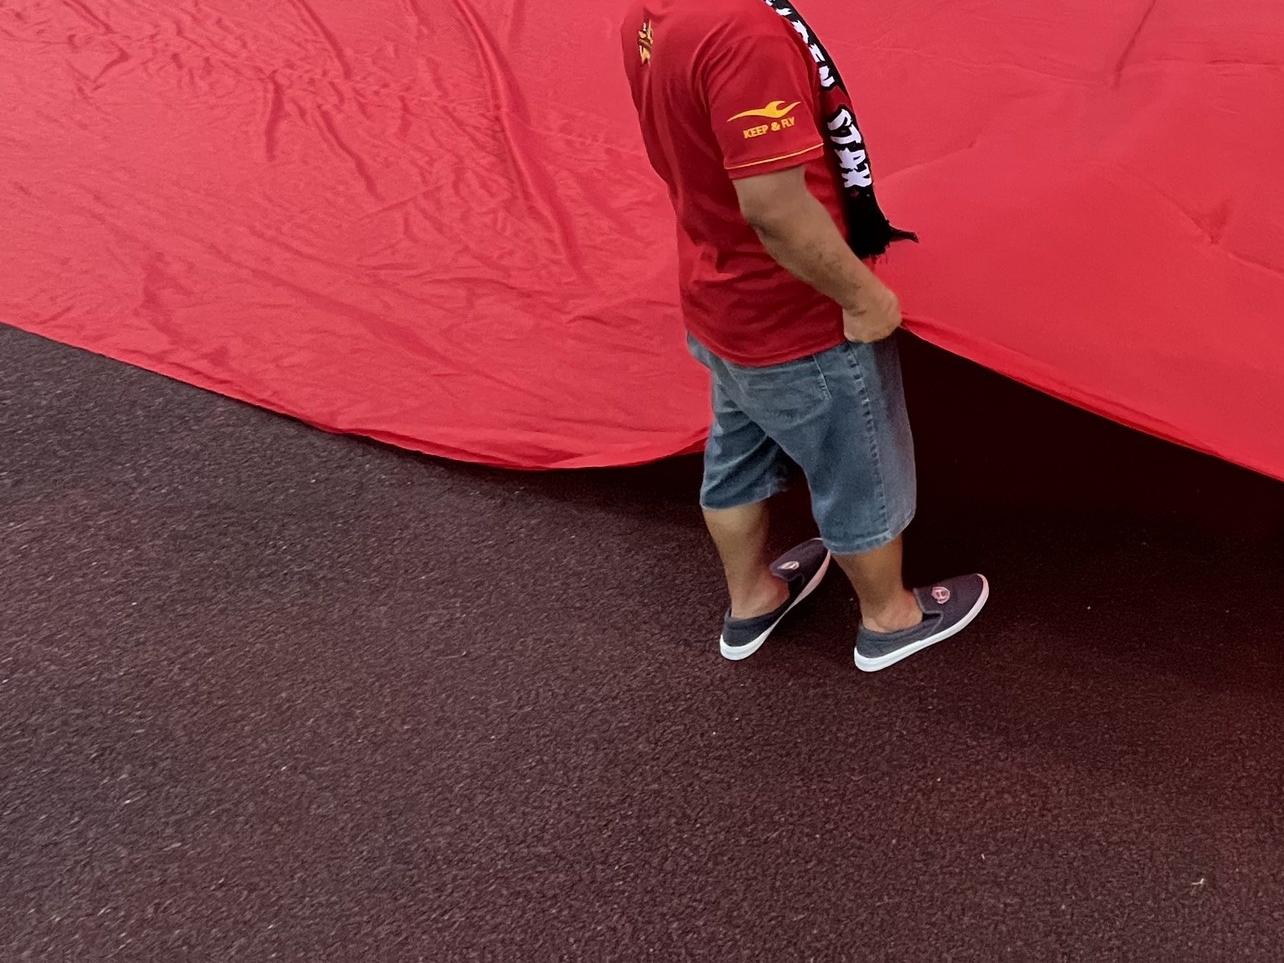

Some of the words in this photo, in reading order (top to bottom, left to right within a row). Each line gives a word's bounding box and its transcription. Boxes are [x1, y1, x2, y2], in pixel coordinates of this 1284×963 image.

[743, 124, 769, 139] KEEP
[771, 121, 780, 131] &
[781, 116, 795, 129] FLY
